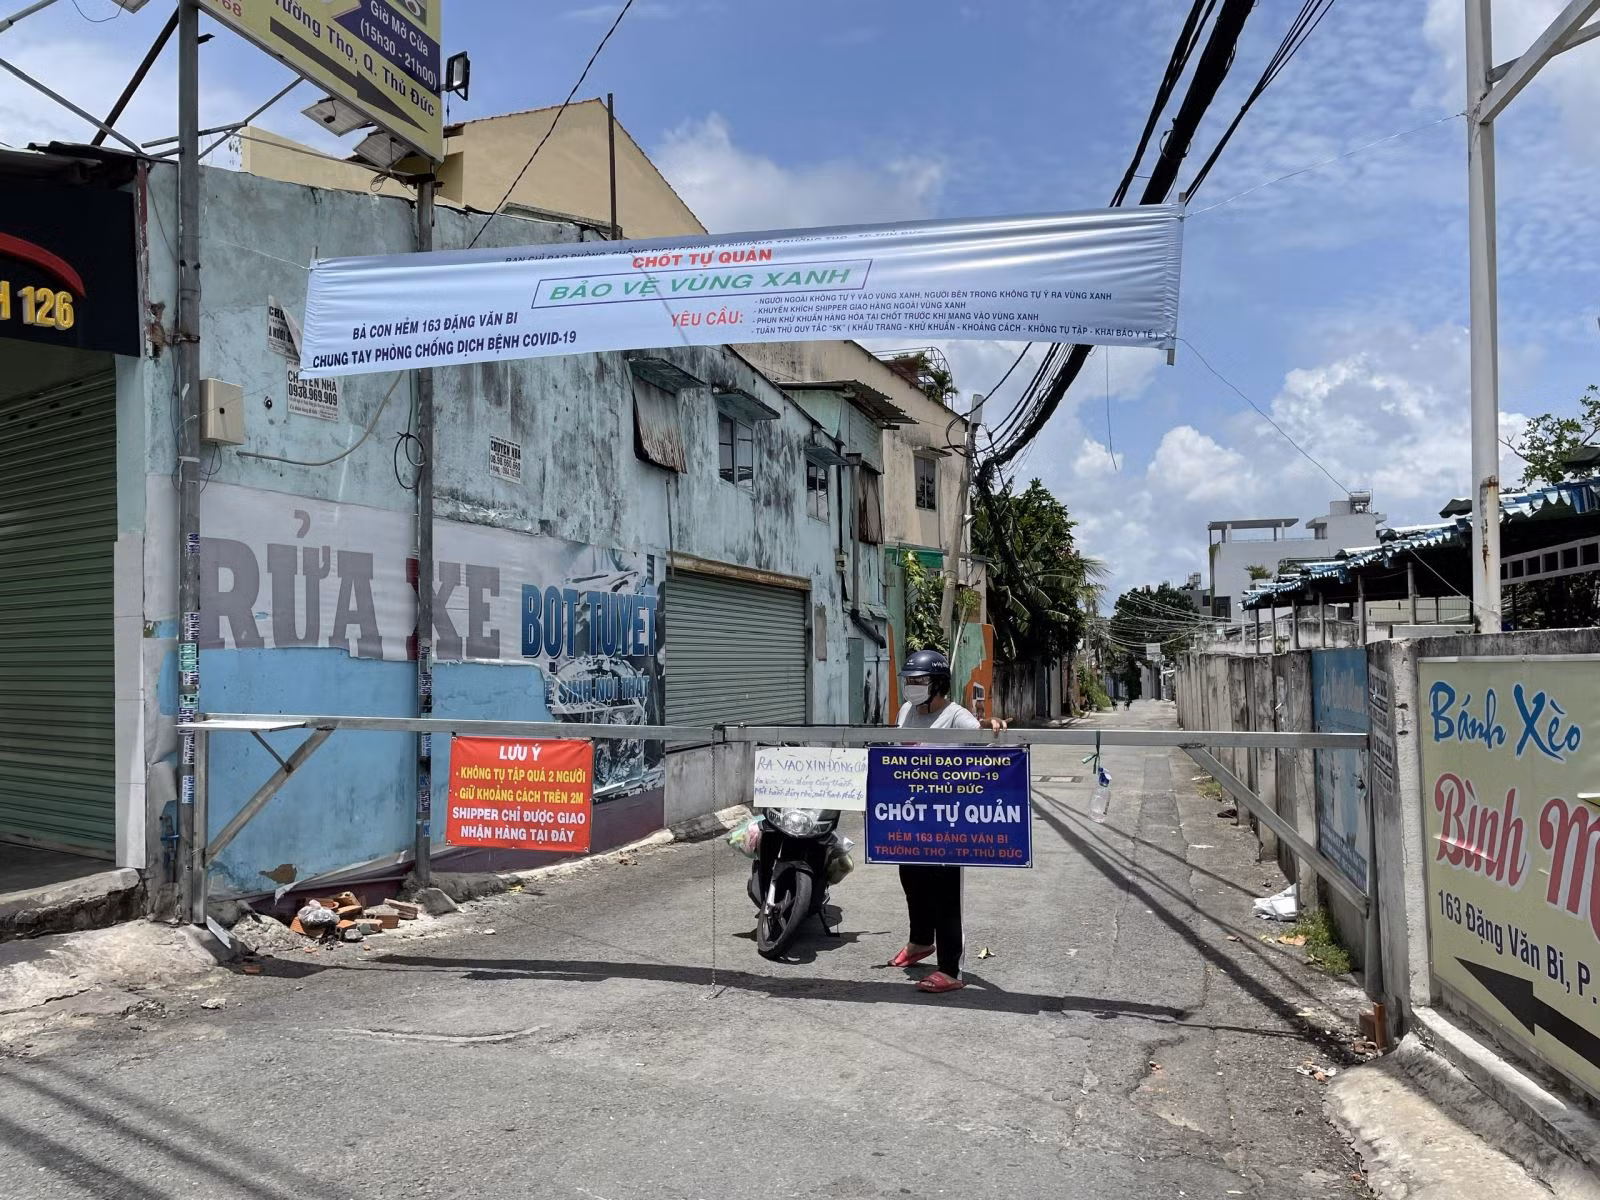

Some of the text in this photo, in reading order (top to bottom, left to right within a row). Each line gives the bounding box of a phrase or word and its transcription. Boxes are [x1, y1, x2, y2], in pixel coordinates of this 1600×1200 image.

[370, 0, 428, 57] Giờ Mở Cửa
[360, 18, 437, 90] (15h30 21h00)
[326, 25, 434, 116] Thọ, Q. Thủ Đức
[632, 250, 682, 269] CHỐT
[689, 250, 714, 268] TỰ
[719, 246, 772, 264] QUẢN
[549, 268, 851, 300] BẢO VỆ VÙNG XANH
[760, 296, 783, 304] NGƯỜI
[810, 293, 836, 302] KHÔNG
[876, 291, 897, 300] VÙNG
[951, 290, 968, 298] BÊN
[1000, 289, 1028, 298] KHÔNG
[1030, 290, 1041, 299] TỰ
[1064, 290, 1088, 299] VÙNG
[1090, 292, 1112, 300] XANH
[790, 304, 814, 312] KHÍCH
[815, 304, 848, 312] SHIPPER
[849, 303, 868, 311] GIAO
[869, 302, 892, 310] HÀNG
[894, 301, 918, 309] NGOÀI
[920, 300, 942, 309] VÙNG
[944, 301, 966, 309] XANH
[17, 286, 74, 330] 126
[671, 306, 744, 327] YÊU CẦU:
[756, 316, 777, 324] PHUN
[824, 313, 846, 321] HÀNG
[904, 311, 931, 320] TRƯỚC
[933, 312, 946, 320] KHI
[948, 312, 972, 320] MANG
[973, 311, 991, 320] VÀO
[992, 311, 1015, 320] VÙNG
[1017, 313, 1039, 321] XANH
[352, 312, 518, 340] BÀ CON HẺM 163 ĐẶNG VĂN BI
[755, 326, 776, 334] TUÂN
[777, 324, 792, 333] THỦ
[794, 325, 810, 333] QUY
[876, 323, 902, 331] TRANG
[909, 321, 926, 331] KHỬ
[928, 320, 956, 331] KHUẨN
[962, 322, 996, 332] KHOẢNG
[998, 322, 1021, 332] CÁCH
[1028, 324, 1057, 334] KHÔNG
[1059, 325, 1070, 335] TỤ
[1072, 324, 1088, 336] TẬP
[1095, 328, 1114, 336] KHAI
[1116, 328, 1134, 337] BÁO
[1136, 330, 1140, 338] Y
[313, 330, 577, 368] CHUNG TAY PHÒNG CHỐNG DỊCH BỆNH COVID-19
[288, 383, 338, 406] 0938.969.909
[199, 509, 500, 662] RỬA XE
[521, 576, 658, 675] BỌT TUYẾT
[1429, 681, 1507, 750] Bánh
[1514, 684, 1581, 761] Xèo
[498, 743, 542, 761] LƯU Ý
[882, 753, 1011, 768] BAN CHỈ ĐẠO PHÒNG
[460, 764, 586, 784] KHÔNG TỤ TẬP QUÁ 2 NGƯỜI
[756, 756, 773, 771] RA
[806, 760, 825, 771] XIN
[894, 768, 1000, 781] CHỐNG COVID-19
[477, 785, 514, 801] KHOẢNG
[516, 787, 541, 802] CÁCH
[543, 789, 568, 804] TRÊN
[570, 792, 584, 804] 2M
[908, 782, 984, 794] TP.THỦ ĐỨC
[452, 806, 586, 826] SHIPPER CHỈ ĐƯỢC GIAO
[874, 797, 1021, 828] CHỐT TỰ QUẢN
[461, 824, 575, 844] NHẬN HÀNG TẠI ĐÂY
[888, 829, 913, 842] HẺM
[916, 832, 933, 842] 163
[971, 832, 994, 844] VĂN
[998, 834, 1008, 843] BI
[1434, 773, 1526, 886] Bình
[875, 844, 1023, 858] TRƯỜNG THỌ TP.THỦ ĐỨC
[1438, 889, 1462, 925] 163
[1466, 902, 1503, 955] Đặng
[1508, 924, 1540, 970] Văn
[1546, 944, 1571, 994] Bi,
